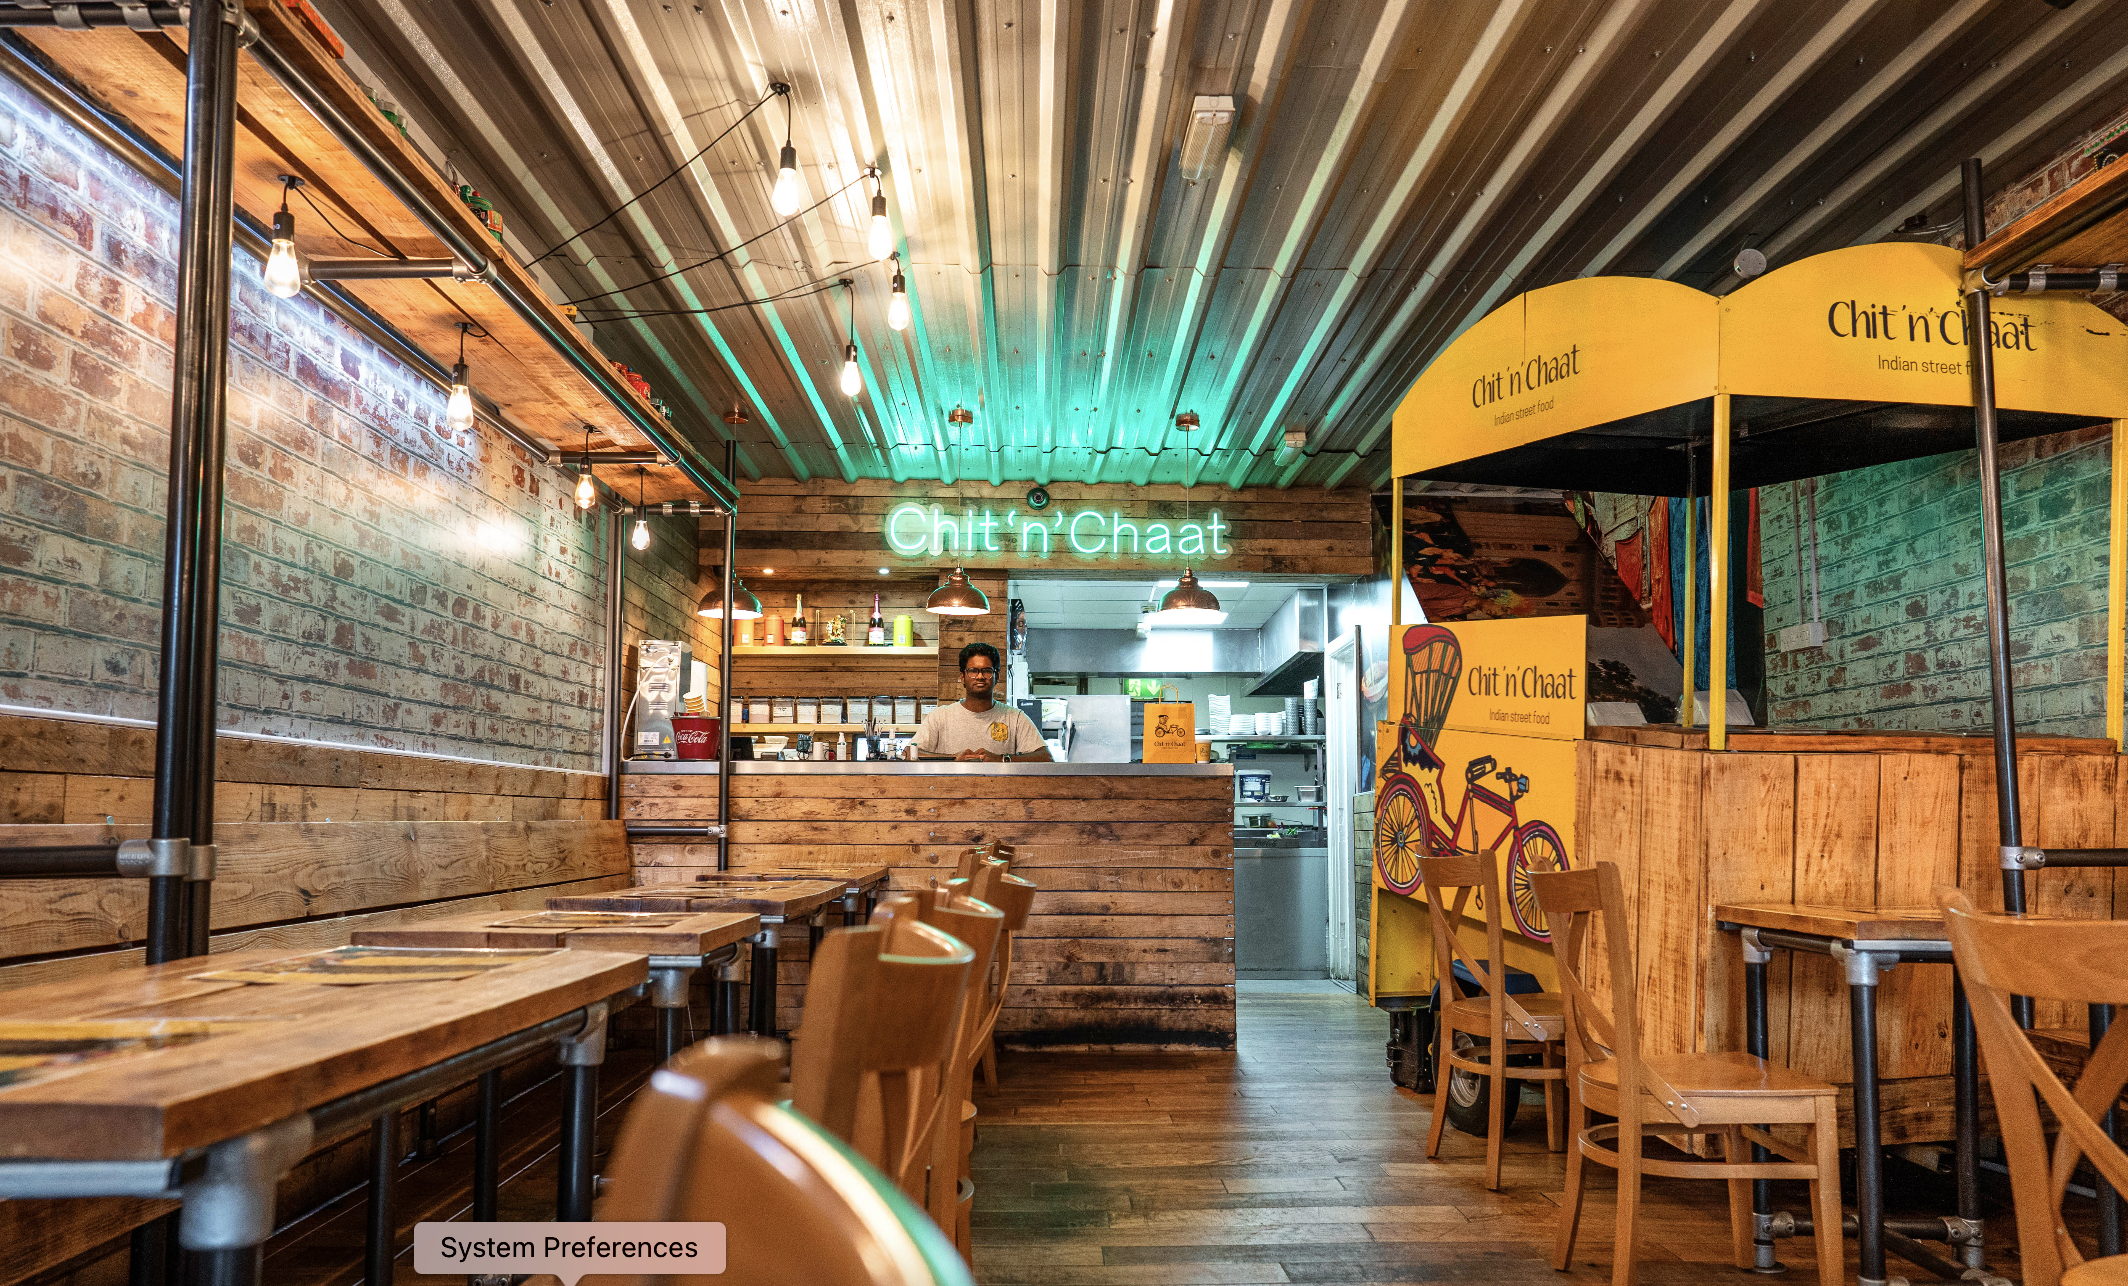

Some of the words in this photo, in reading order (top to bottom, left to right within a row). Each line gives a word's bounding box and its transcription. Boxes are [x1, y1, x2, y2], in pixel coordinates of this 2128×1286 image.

[1828, 299, 1897, 340] Chit
[1472, 372, 1504, 408] Chit
[1526, 344, 1581, 391] Chaat
[1878, 355, 1918, 371] Indian
[1921, 360, 1962, 375] street
[1494, 411, 1515, 426] Indian
[1515, 404, 1536, 420] street
[1537, 396, 1555, 413] food
[890, 507, 999, 551] Chit
[1070, 511, 1228, 553] Chaat
[1468, 665, 1501, 696] Chit
[1521, 665, 1577, 700] Chaat
[1489, 708, 1509, 721] Indian
[1510, 711, 1532, 724] street
[1533, 710, 1550, 725] food
